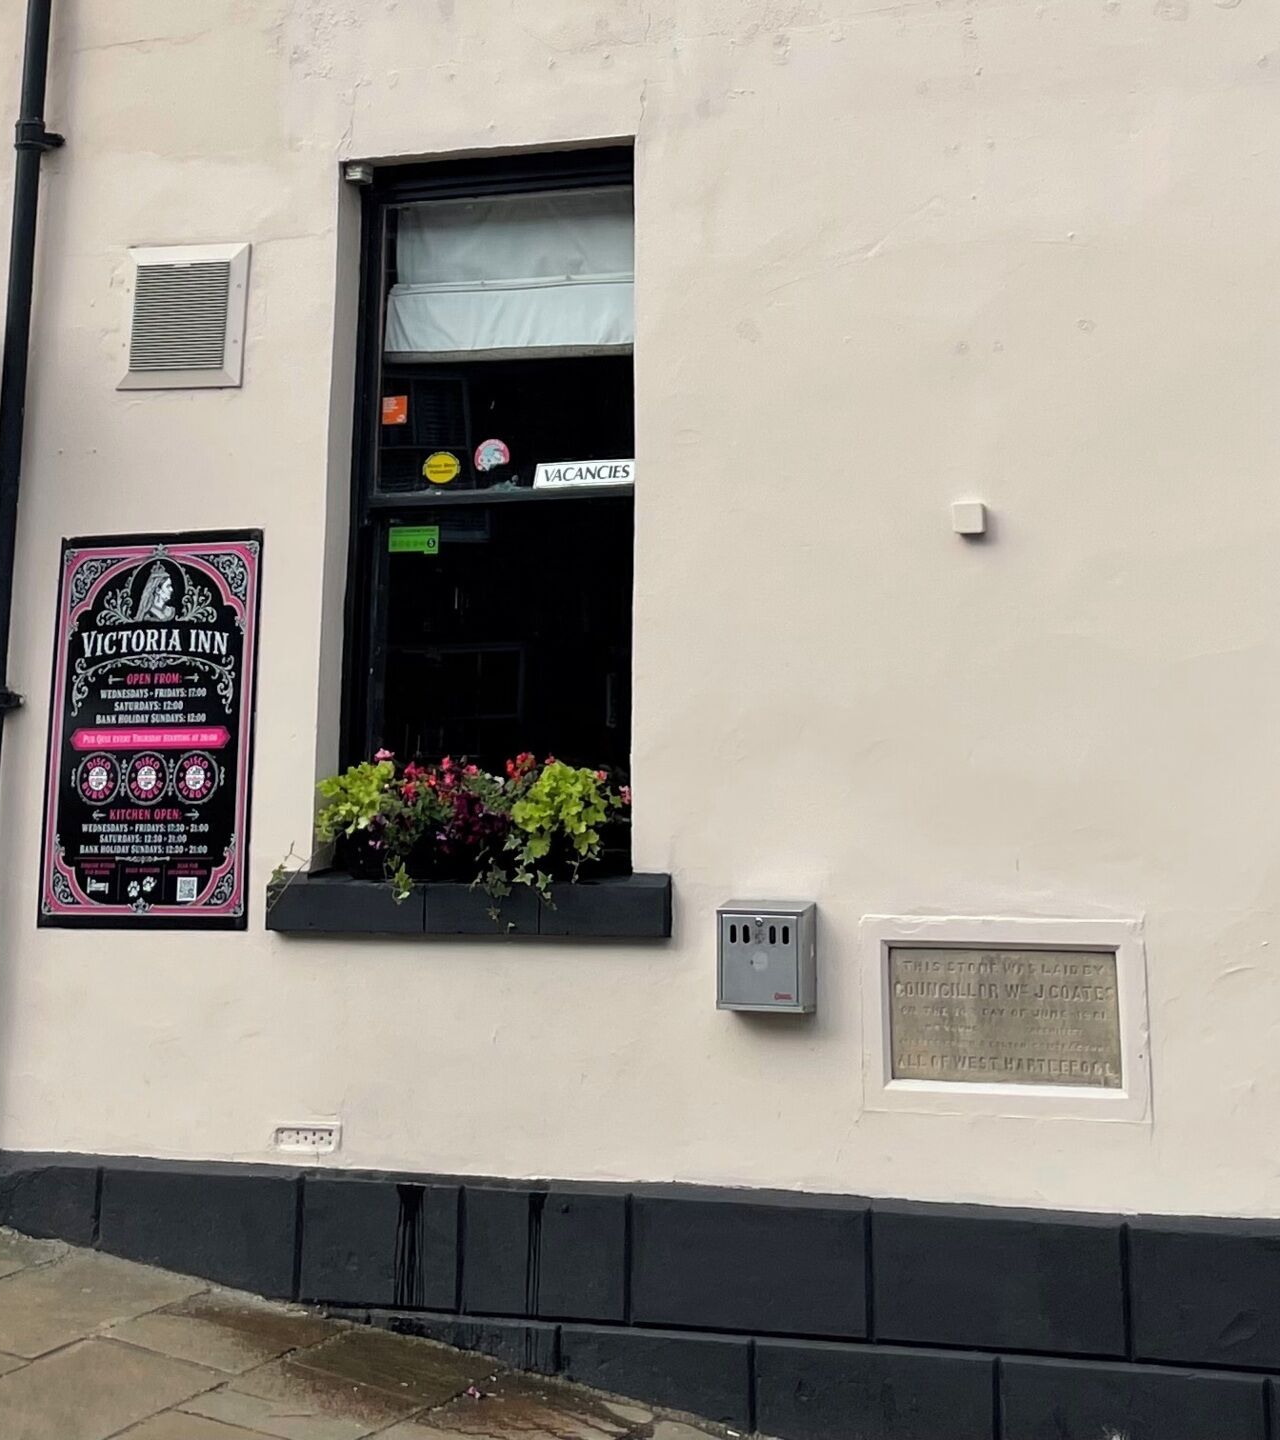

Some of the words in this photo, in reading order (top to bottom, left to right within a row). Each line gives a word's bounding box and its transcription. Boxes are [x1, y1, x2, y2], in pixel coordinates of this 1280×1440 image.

[544, 464, 631, 482] VACANCIES
[82, 629, 182, 657] VICTORIA
[189, 629, 229, 655] INN
[126, 673, 151, 685] OPEN
[154, 673, 182, 684] FROM:
[100, 688, 148, 699] WEDNESDAYS
[154, 688, 187, 698] FRIDAYS:
[114, 701, 161, 711] SATURDAYS:
[96, 714, 116, 724] BANK
[118, 713, 149, 724] HOLIDAY
[150, 713, 186, 723] SUNDAYS:
[87, 757, 111, 771] DISCO
[135, 757, 160, 770] DISCO
[183, 756, 209, 769] DISCO
[81, 780, 115, 800] BURGER
[130, 780, 163, 799] BURGER
[178, 779, 212, 798] BURGER
[109, 809, 151, 820] KITCHEN
[154, 809, 182, 820] OPEN:
[82, 823, 128, 832] WEDNESDAYS
[135, 823, 166, 832] FRIDAYS:
[100, 834, 142, 843] SATURDAYS:
[80, 845, 99, 854] BANK
[100, 845, 129, 854] HOLIDAY
[131, 845, 164, 854] SUNDAYS:
[902, 960, 941, 973] THIS
[1040, 963, 1078, 976] LAID
[894, 980, 999, 1000] COUNCILLOR
[898, 1054, 927, 1069] ALL
[954, 1056, 999, 1071] WEST
[1004, 1057, 1115, 1077] HARTLEPOOL
